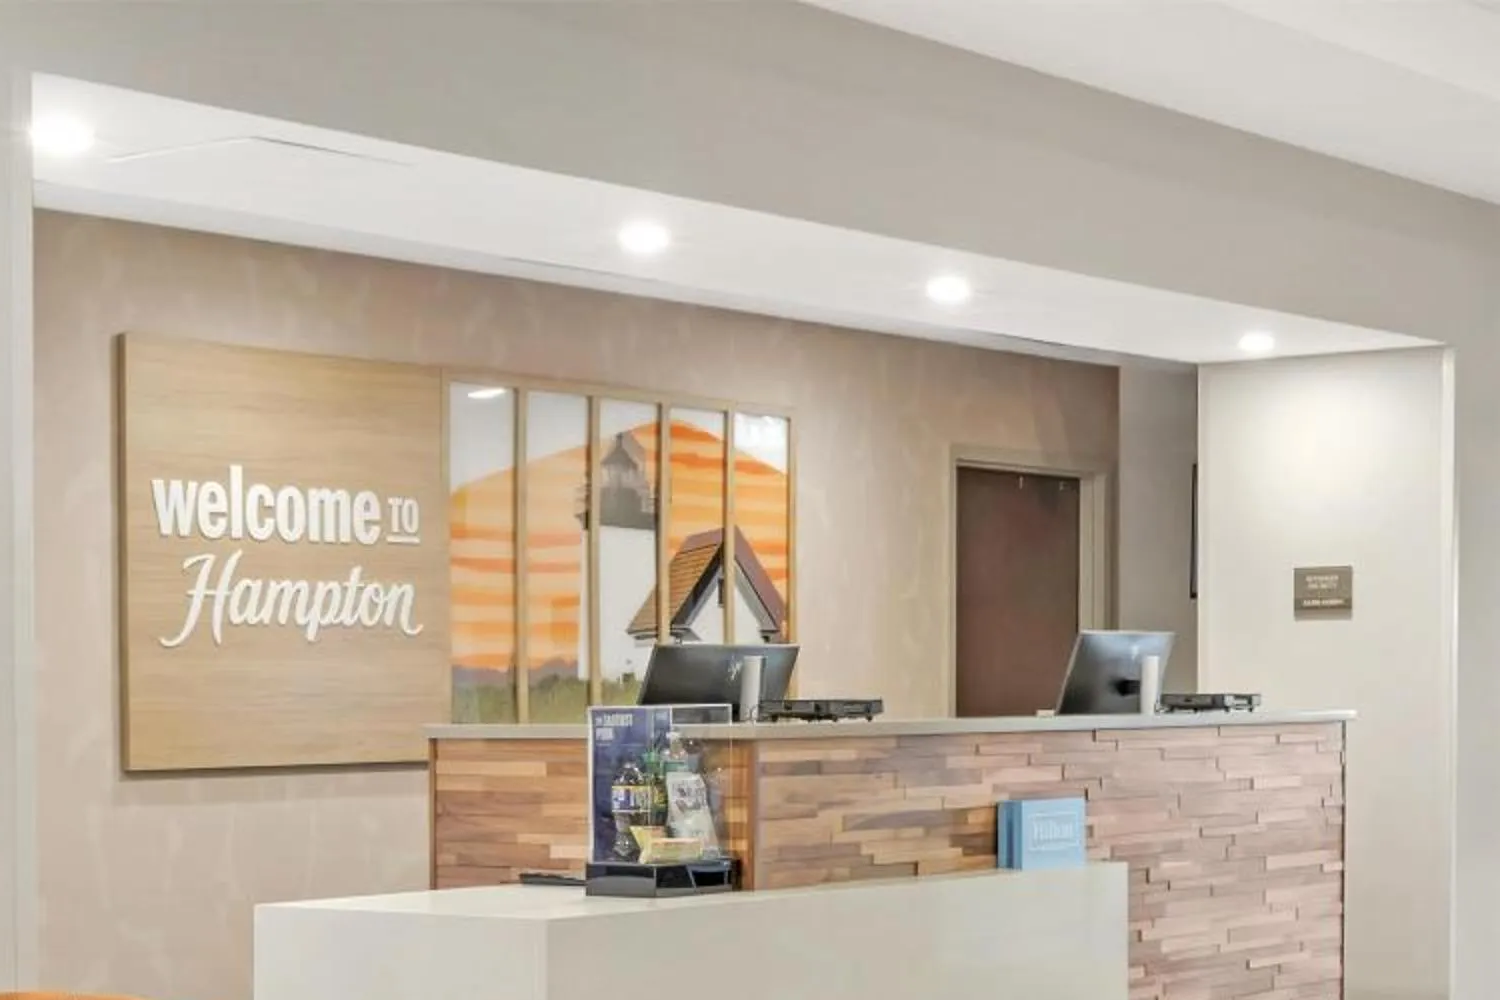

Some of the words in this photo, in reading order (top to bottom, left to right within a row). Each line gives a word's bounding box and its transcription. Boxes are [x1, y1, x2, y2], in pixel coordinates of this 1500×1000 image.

[151, 465, 381, 545] welcome
[387, 497, 419, 536] TO
[159, 549, 423, 647] Hampton
